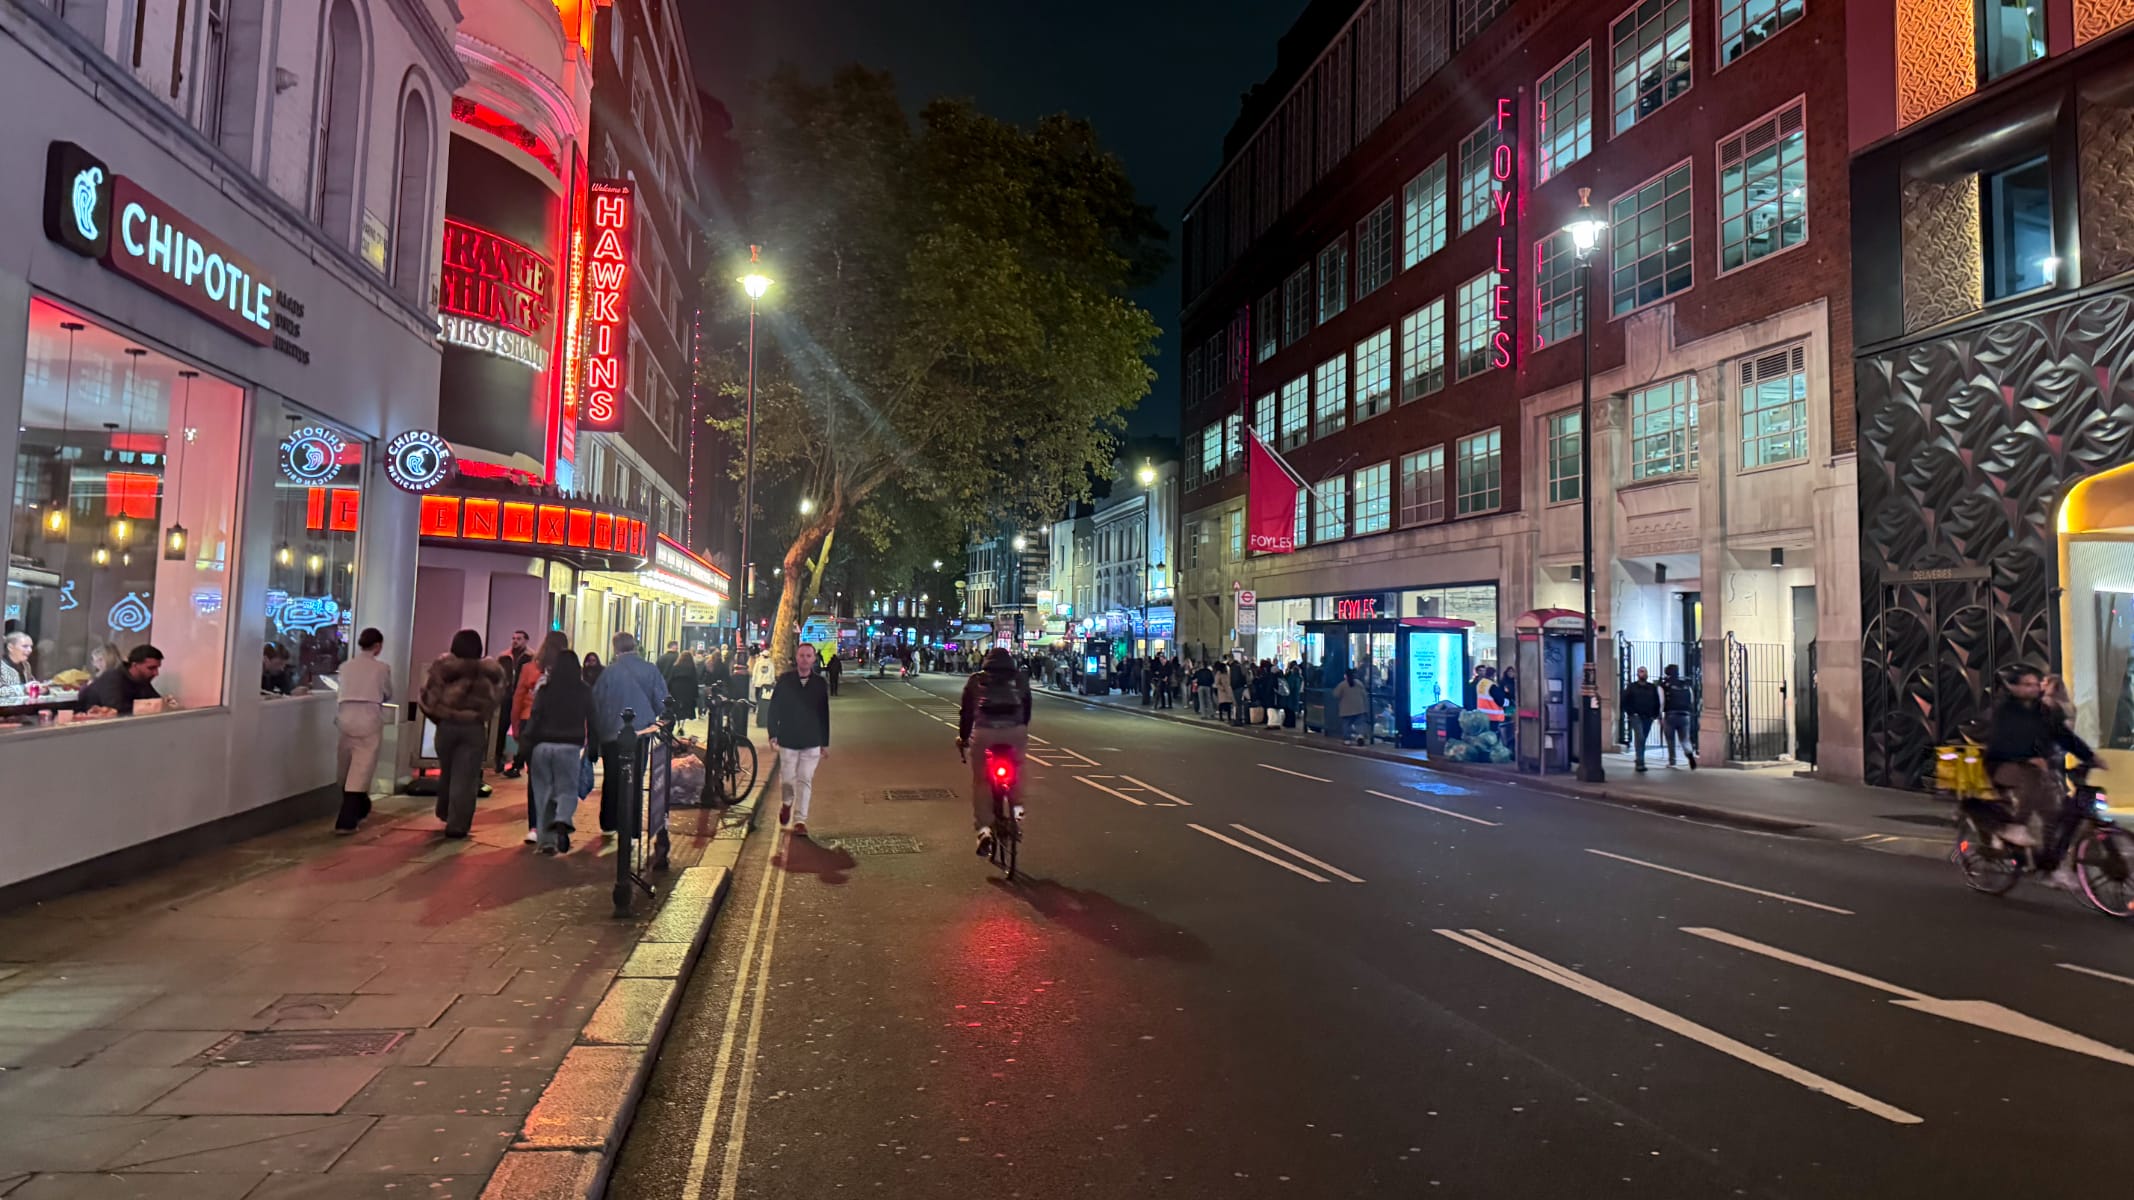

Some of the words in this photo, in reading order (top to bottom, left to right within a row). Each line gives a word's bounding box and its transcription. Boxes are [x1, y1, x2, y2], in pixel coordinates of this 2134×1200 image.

[591, 182, 621, 193] Welcome
[622, 186, 630, 194] to
[1494, 98, 1511, 368] FOYLES
[122, 202, 272, 330] CHIPOTLE
[589, 196, 624, 421] HAWKINS
[442, 317, 503, 353] FIRST
[388, 431, 450, 459] CHIPOTLE
[388, 465, 422, 490] MEXICAN
[424, 469, 447, 489] GRILL
[435, 506, 562, 538] ENIX
[1250, 534, 1292, 548] FOYLES
[1912, 569, 1952, 580] DELIVERIES
[1338, 598, 1377, 620] FOYLES
